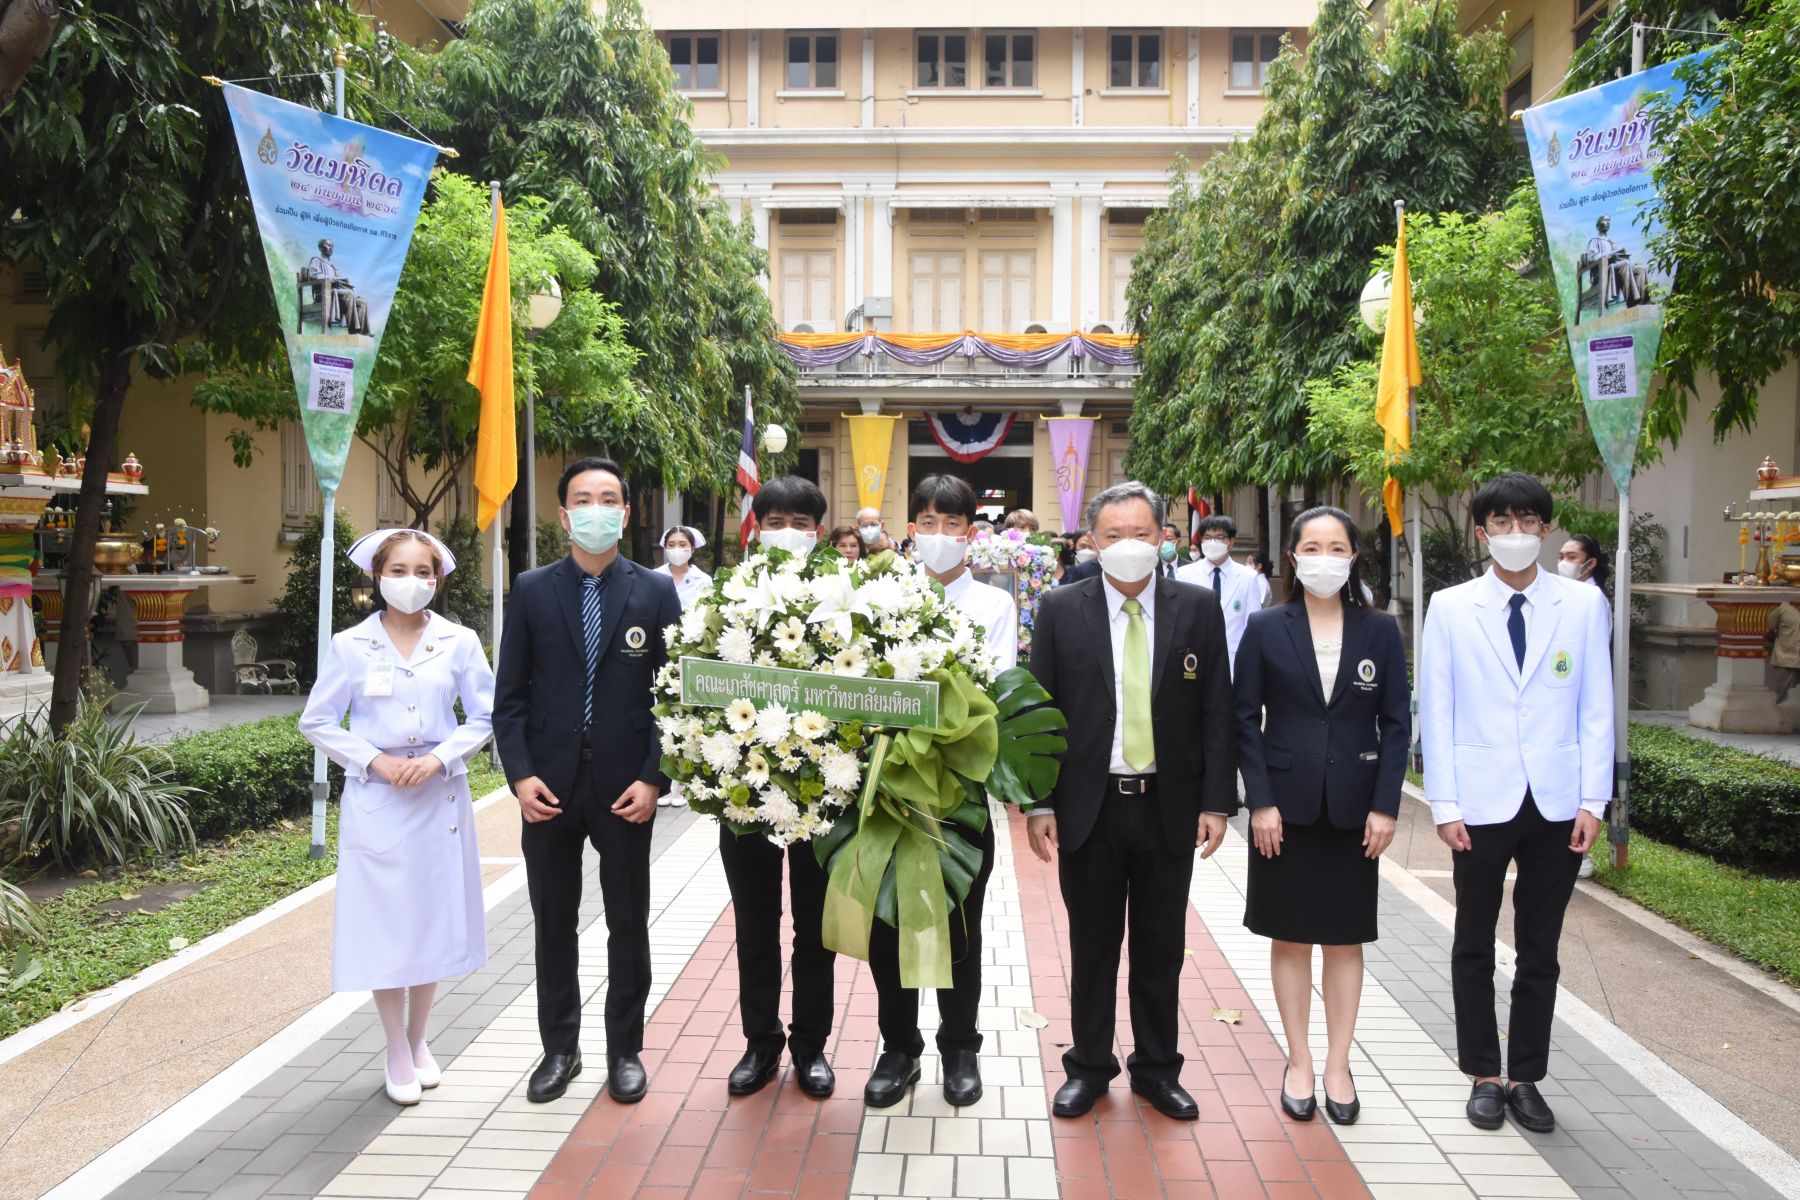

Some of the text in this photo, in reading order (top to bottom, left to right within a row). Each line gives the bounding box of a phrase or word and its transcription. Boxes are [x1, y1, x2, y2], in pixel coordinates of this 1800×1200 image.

[1568, 110, 1665, 160] วันมหิ
[286, 142, 403, 197] วันมหิดล
[695, 672, 921, 716] คณะเภสัชศาสตร์ มหาวิทยาลัยมหิดล
